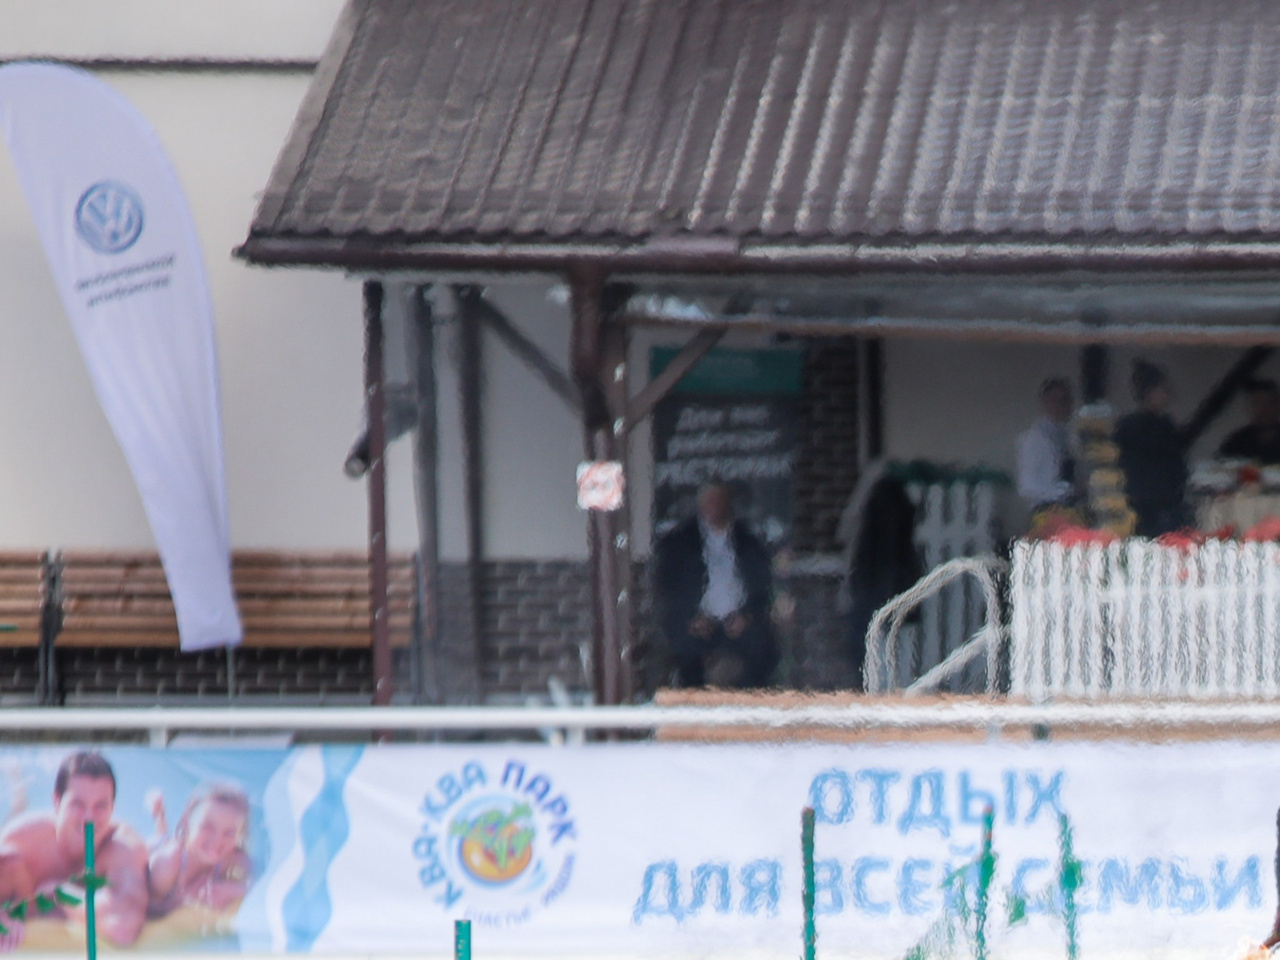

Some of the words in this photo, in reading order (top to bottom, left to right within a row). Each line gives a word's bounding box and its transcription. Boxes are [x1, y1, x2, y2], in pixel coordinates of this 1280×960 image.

[501, 759, 578, 847] ПАРК
[808, 768, 1068, 838] ОТДЫХ
[633, 858, 783, 924] ДЛЯ
